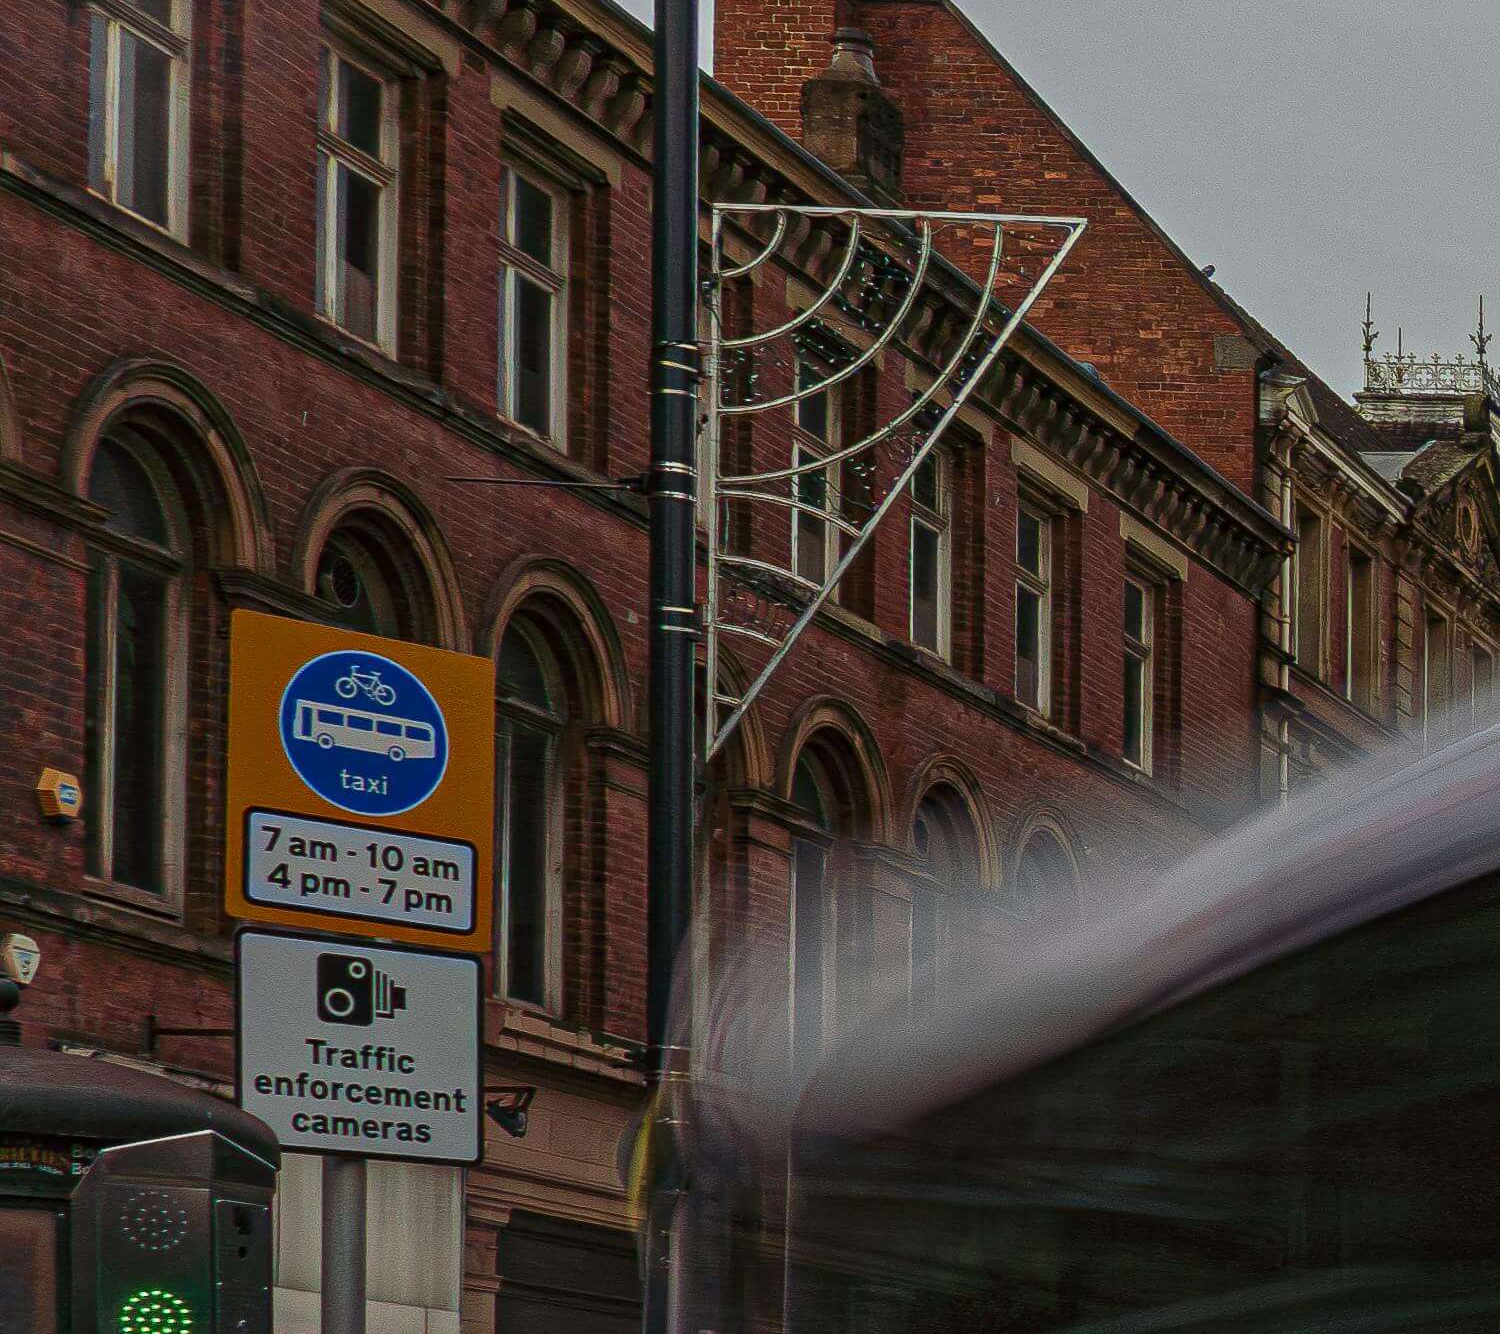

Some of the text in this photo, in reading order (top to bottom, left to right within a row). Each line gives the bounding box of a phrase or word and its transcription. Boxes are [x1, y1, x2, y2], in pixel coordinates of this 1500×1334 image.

[340, 768, 388, 796] taxi
[260, 825, 282, 852] 7
[288, 836, 338, 862] am
[365, 842, 404, 872] 10
[412, 856, 460, 881] am
[267, 863, 291, 888] 4
[300, 872, 351, 898] pm
[377, 878, 398, 905] 7
[404, 888, 452, 914] pm
[303, 1037, 416, 1074] Traffic
[254, 1072, 467, 1113] enforcement
[291, 1111, 432, 1143] cameras
